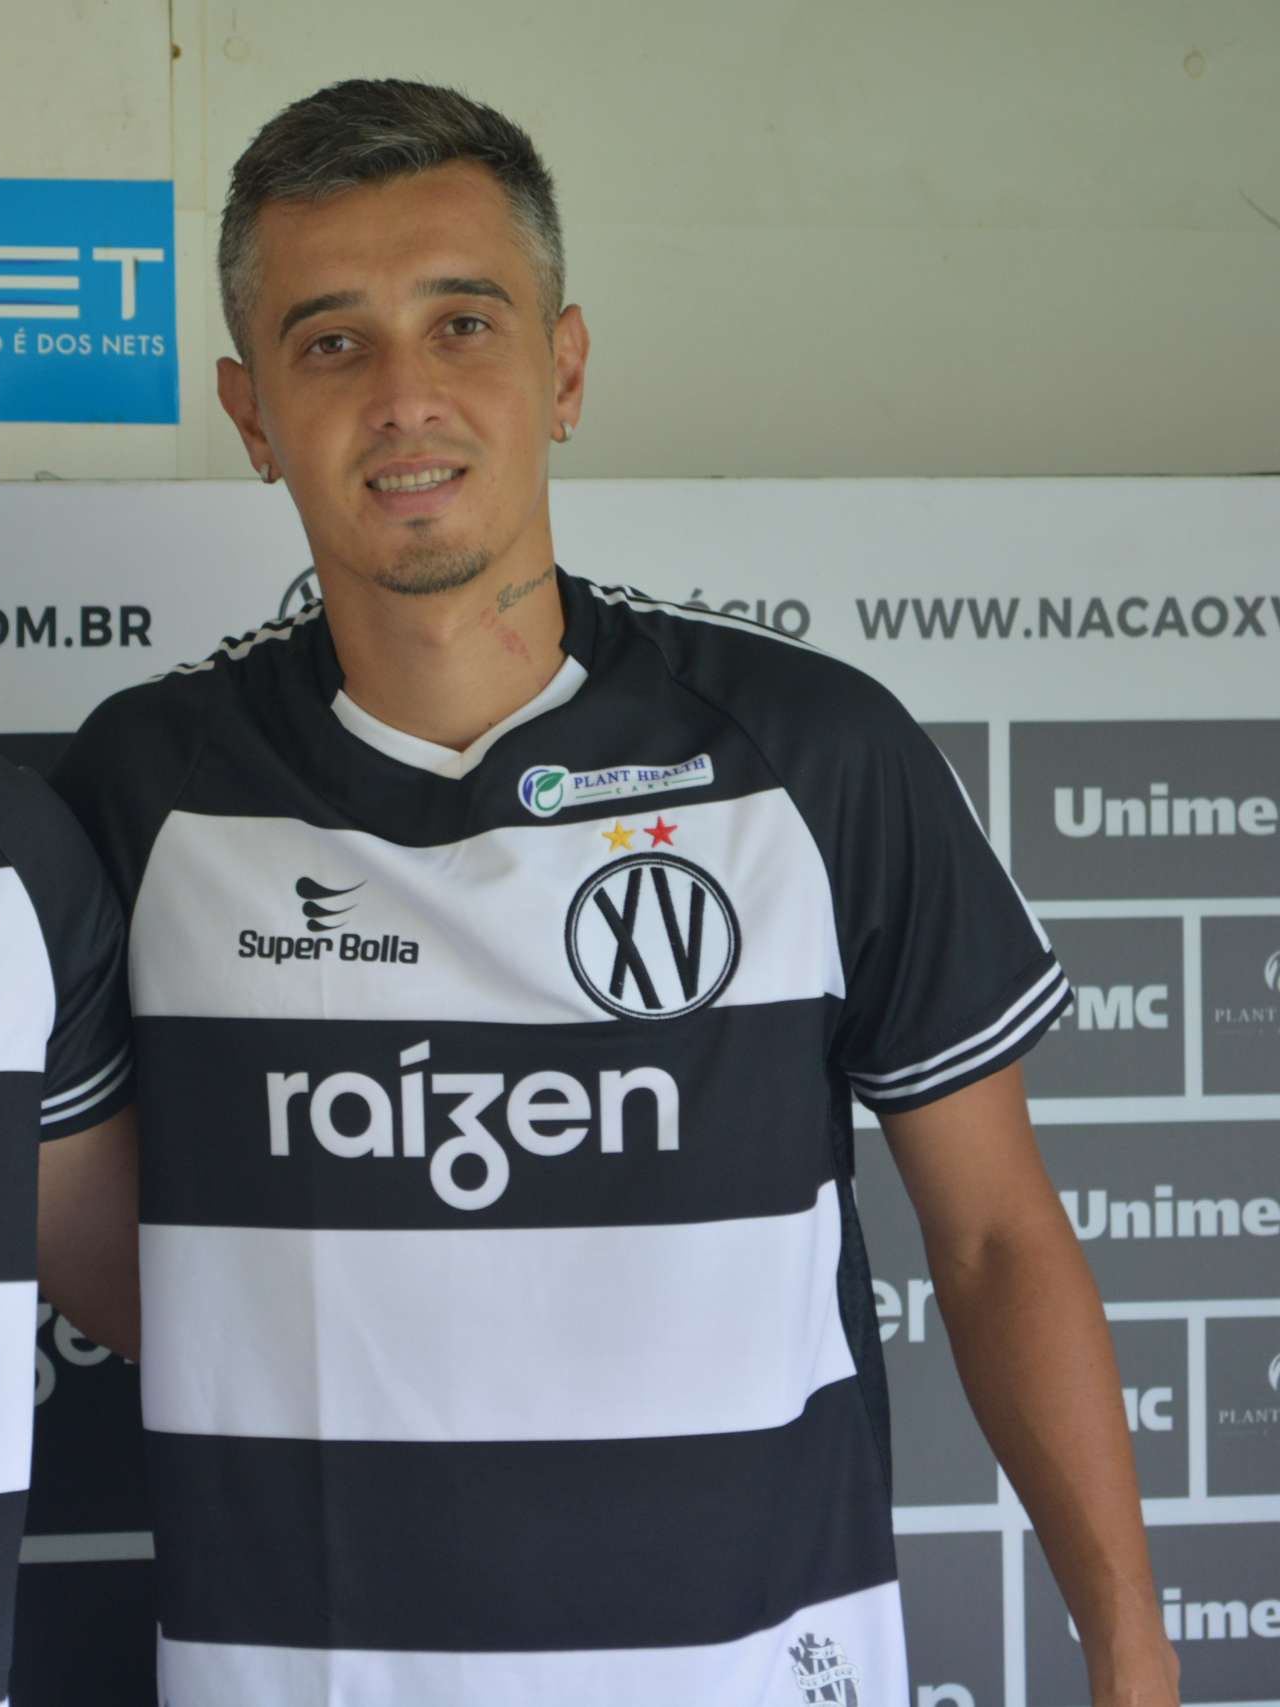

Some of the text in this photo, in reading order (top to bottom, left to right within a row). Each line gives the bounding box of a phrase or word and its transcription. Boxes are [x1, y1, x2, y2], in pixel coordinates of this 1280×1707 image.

[13, 327, 27, 354] É
[37, 333, 91, 355] DOS
[102, 335, 165, 357] NETS
[855, 596, 1280, 641] WWW.NACAOX
[573, 757, 707, 790] PLANT HEALTH
[1053, 782, 1279, 838] Unime
[238, 930, 420, 964] Super Bolla
[592, 866, 707, 1011] XV
